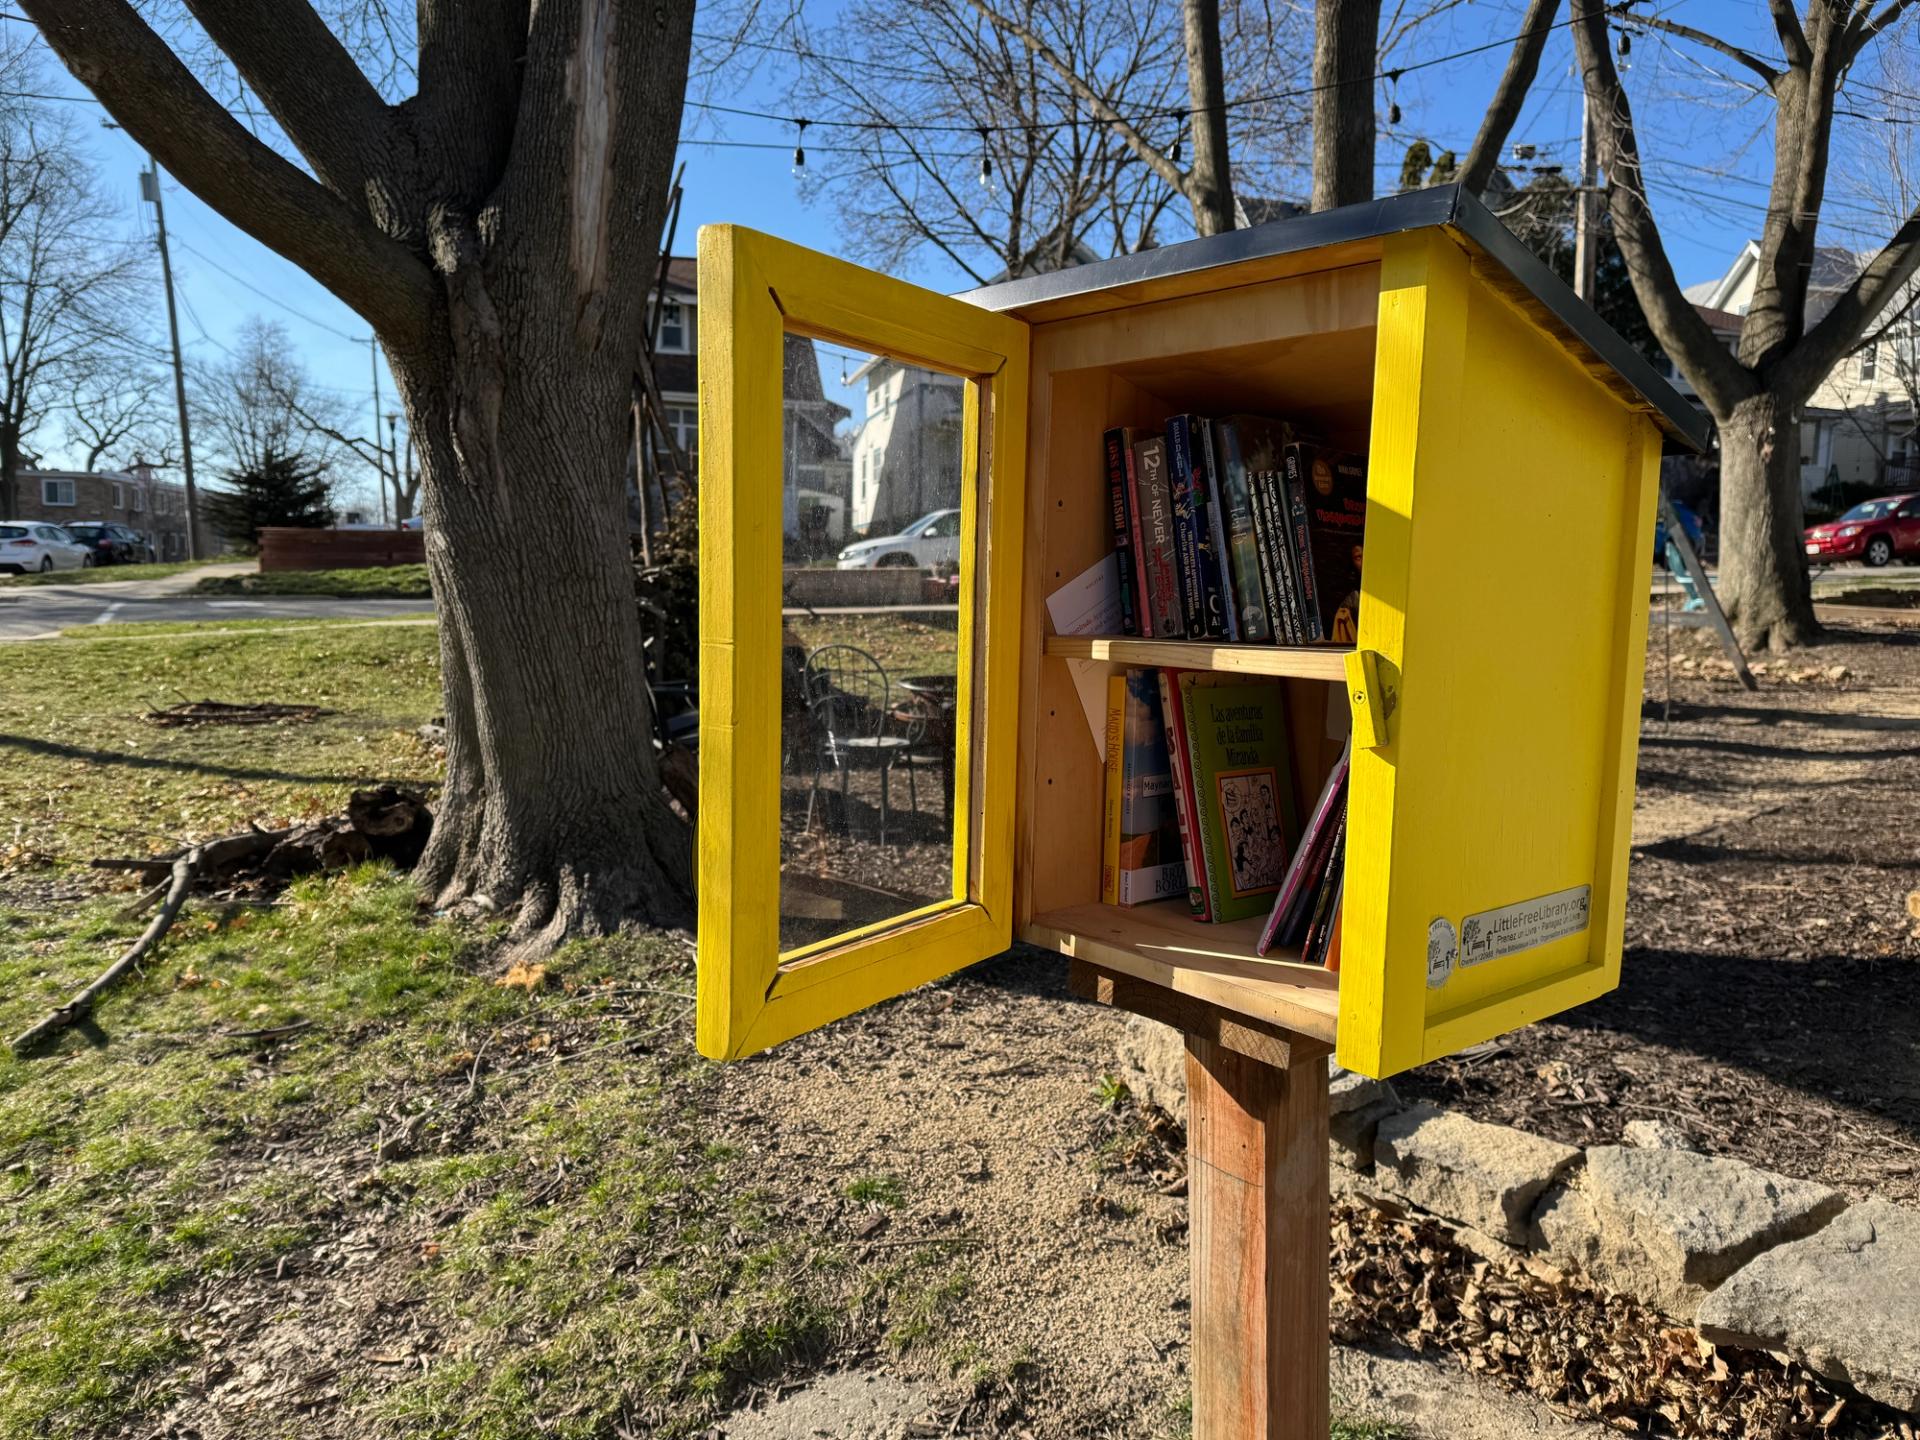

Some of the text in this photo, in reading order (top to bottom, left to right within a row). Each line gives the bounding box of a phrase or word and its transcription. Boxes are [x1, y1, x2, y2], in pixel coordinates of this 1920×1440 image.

[1175, 444, 1184, 477] DAHL
[1286, 456, 1298, 479] GRIMES
[1108, 440, 1126, 530] LOSS OF REASON
[1143, 445, 1166, 544] 12TH OF NEVER
[1179, 522, 1188, 551] Charlie
[1210, 704, 1264, 722] Las aventuras
[1216, 726, 1225, 745] de
[1226, 725, 1234, 743] la
[1108, 743, 1119, 774] HOUSE
[1226, 747, 1259, 766] Miranda
[1493, 897, 1586, 933] LittleFreeLibrary.org
[1496, 933, 1517, 945] Prenez
